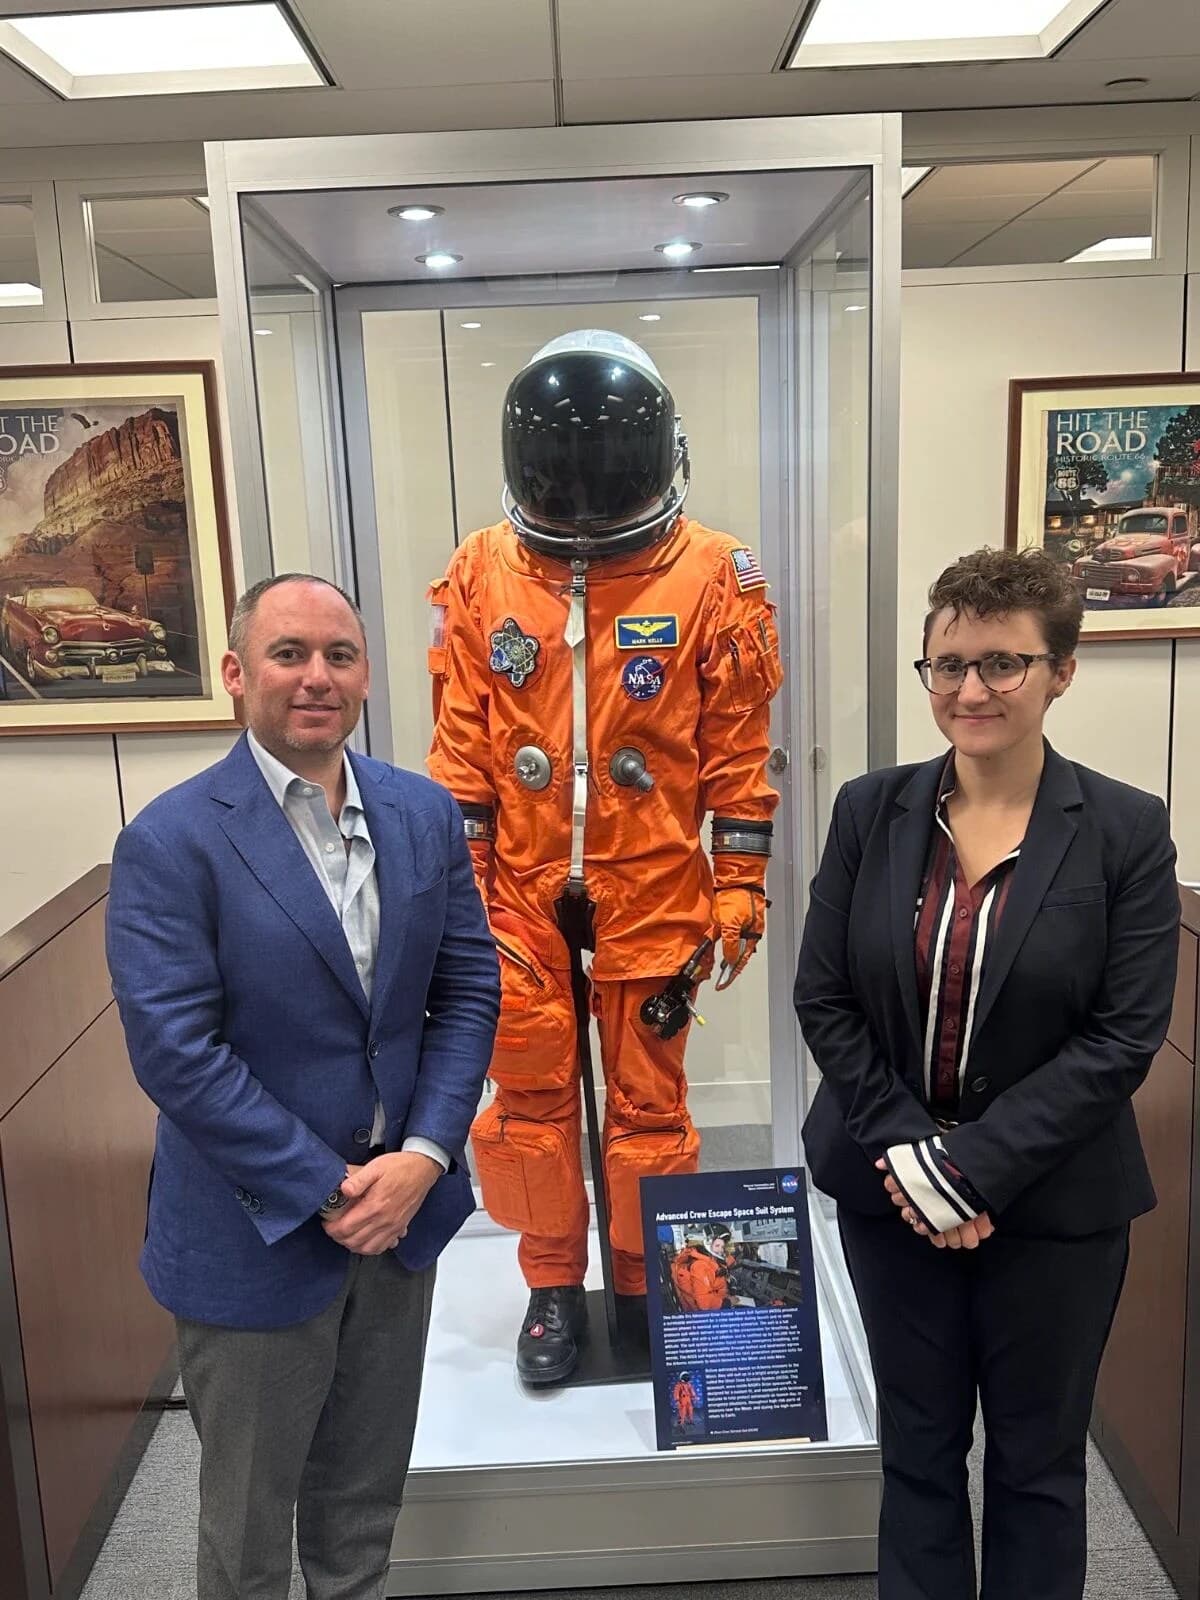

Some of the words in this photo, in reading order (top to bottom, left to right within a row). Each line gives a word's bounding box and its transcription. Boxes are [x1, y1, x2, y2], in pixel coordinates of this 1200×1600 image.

[15, 415, 60, 433] THE
[1057, 412, 1097, 432] HIT
[1102, 410, 1149, 430] THE
[1056, 430, 1146, 455] ROAD
[1055, 455, 1098, 463] HISTORIC
[628, 673, 661, 685] NASA
[655, 1212, 689, 1222] Advanced
[689, 1210, 707, 1220] Crew
[708, 1209, 732, 1219] Escape
[733, 1207, 754, 1218] Space
[755, 1206, 769, 1216] Suit
[769, 1205, 795, 1216] System
